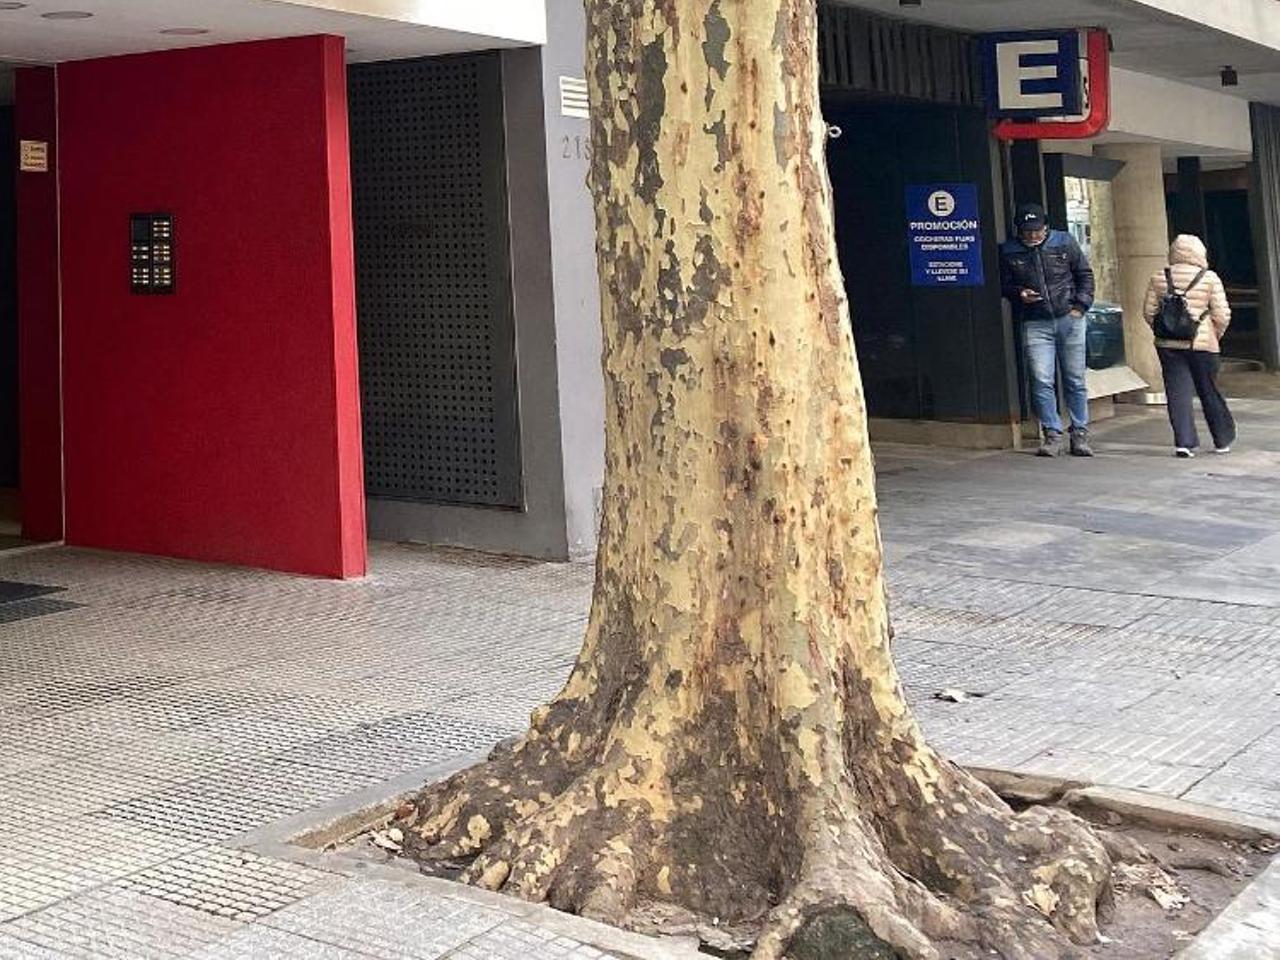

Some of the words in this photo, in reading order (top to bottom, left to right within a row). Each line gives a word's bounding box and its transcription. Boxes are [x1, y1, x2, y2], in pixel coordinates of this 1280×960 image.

[996, 40, 1063, 109] E
[934, 196, 948, 211] E
[910, 219, 977, 230] PROMOCIÓN
